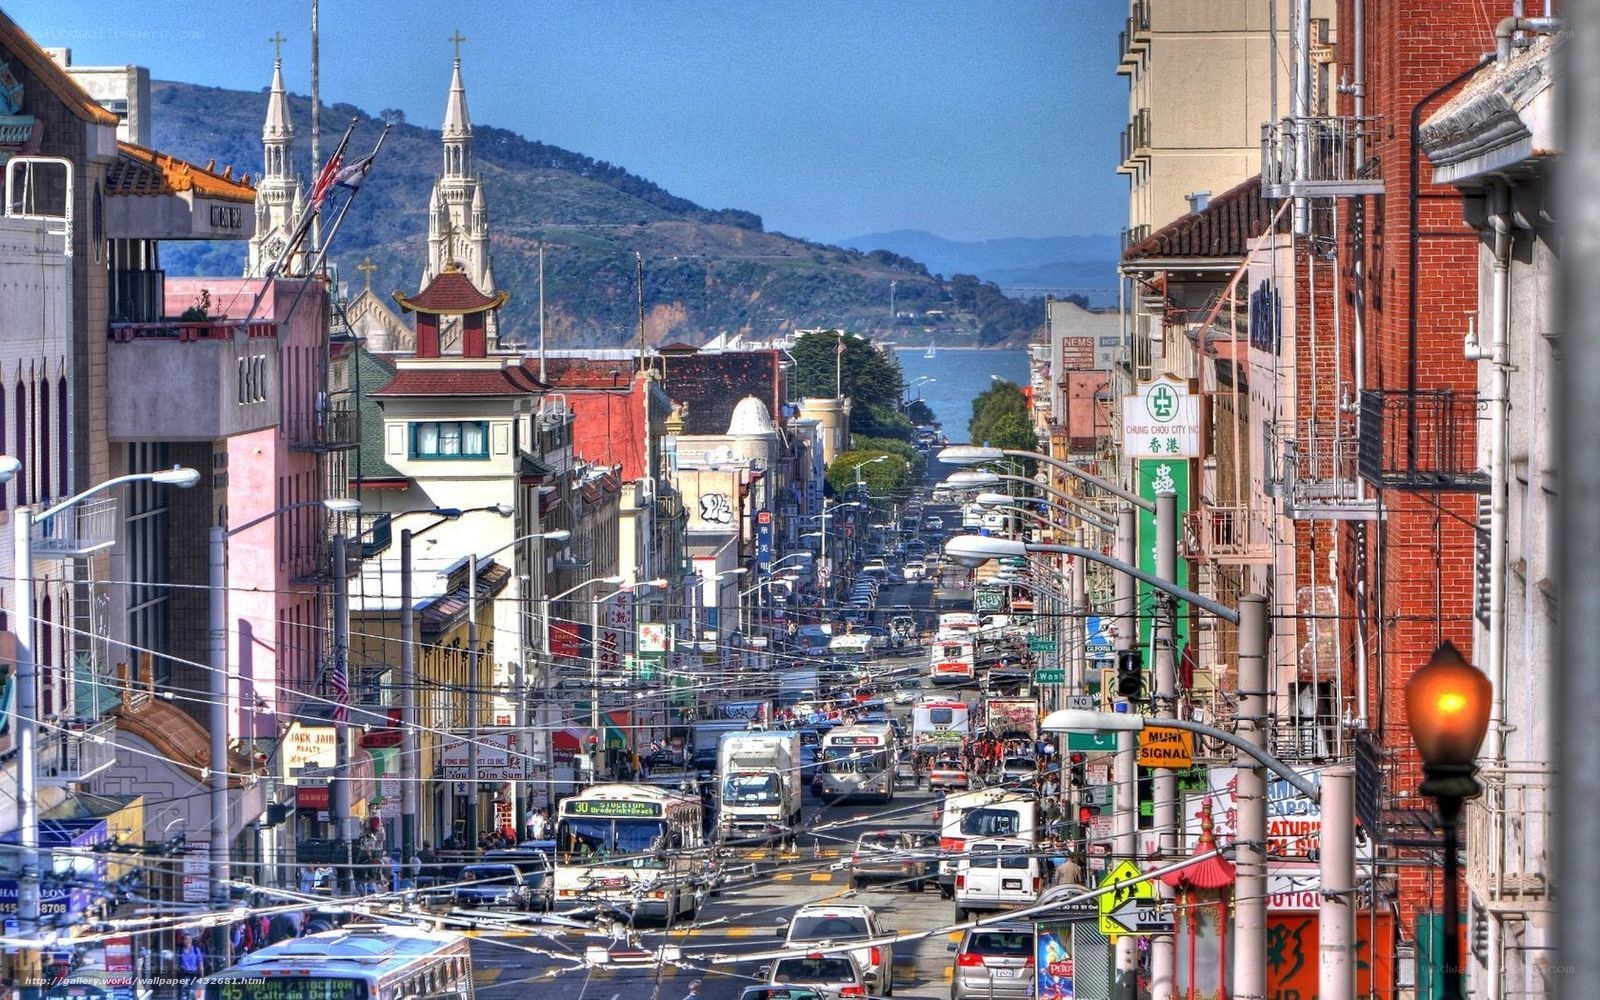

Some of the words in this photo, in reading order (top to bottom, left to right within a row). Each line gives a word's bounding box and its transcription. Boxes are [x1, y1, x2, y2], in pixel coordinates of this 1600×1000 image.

[1064, 338, 1093, 347] NEMS
[1126, 425, 1149, 435] CHUNG
[1151, 425, 1169, 435] CHOU
[1171, 425, 1187, 435] CITY
[1149, 437, 1180, 453] 香港
[1073, 698, 1087, 706] NO
[289, 733, 311, 743] JACK
[315, 734, 335, 745] JAIR
[1148, 731, 1182, 743] MUNI
[1141, 747, 1189, 759] SIGNAL
[478, 770, 498, 779] Dim
[502, 770, 522, 779] Sum
[575, 802, 588, 813] 30
[1137, 909, 1167, 922] ONE
[222, 984, 242, 1000] 45
[254, 990, 303, 1000] Caltrain
